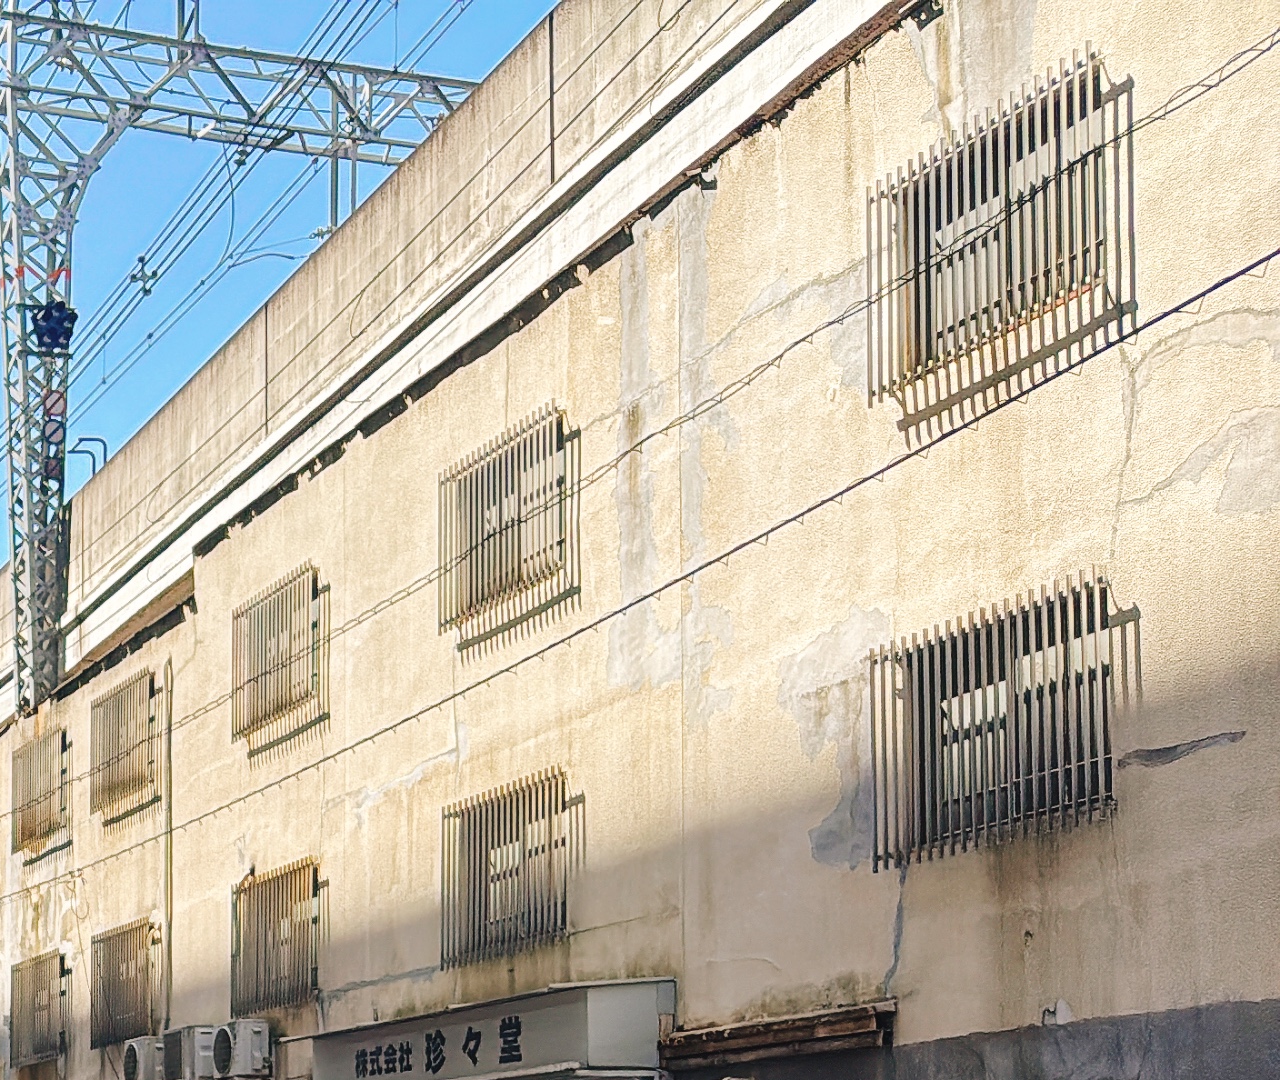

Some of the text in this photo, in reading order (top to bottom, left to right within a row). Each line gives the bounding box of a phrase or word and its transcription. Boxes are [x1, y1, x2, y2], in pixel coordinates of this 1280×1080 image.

[355, 1015, 523, 1079] 株式会社 珍々堂
